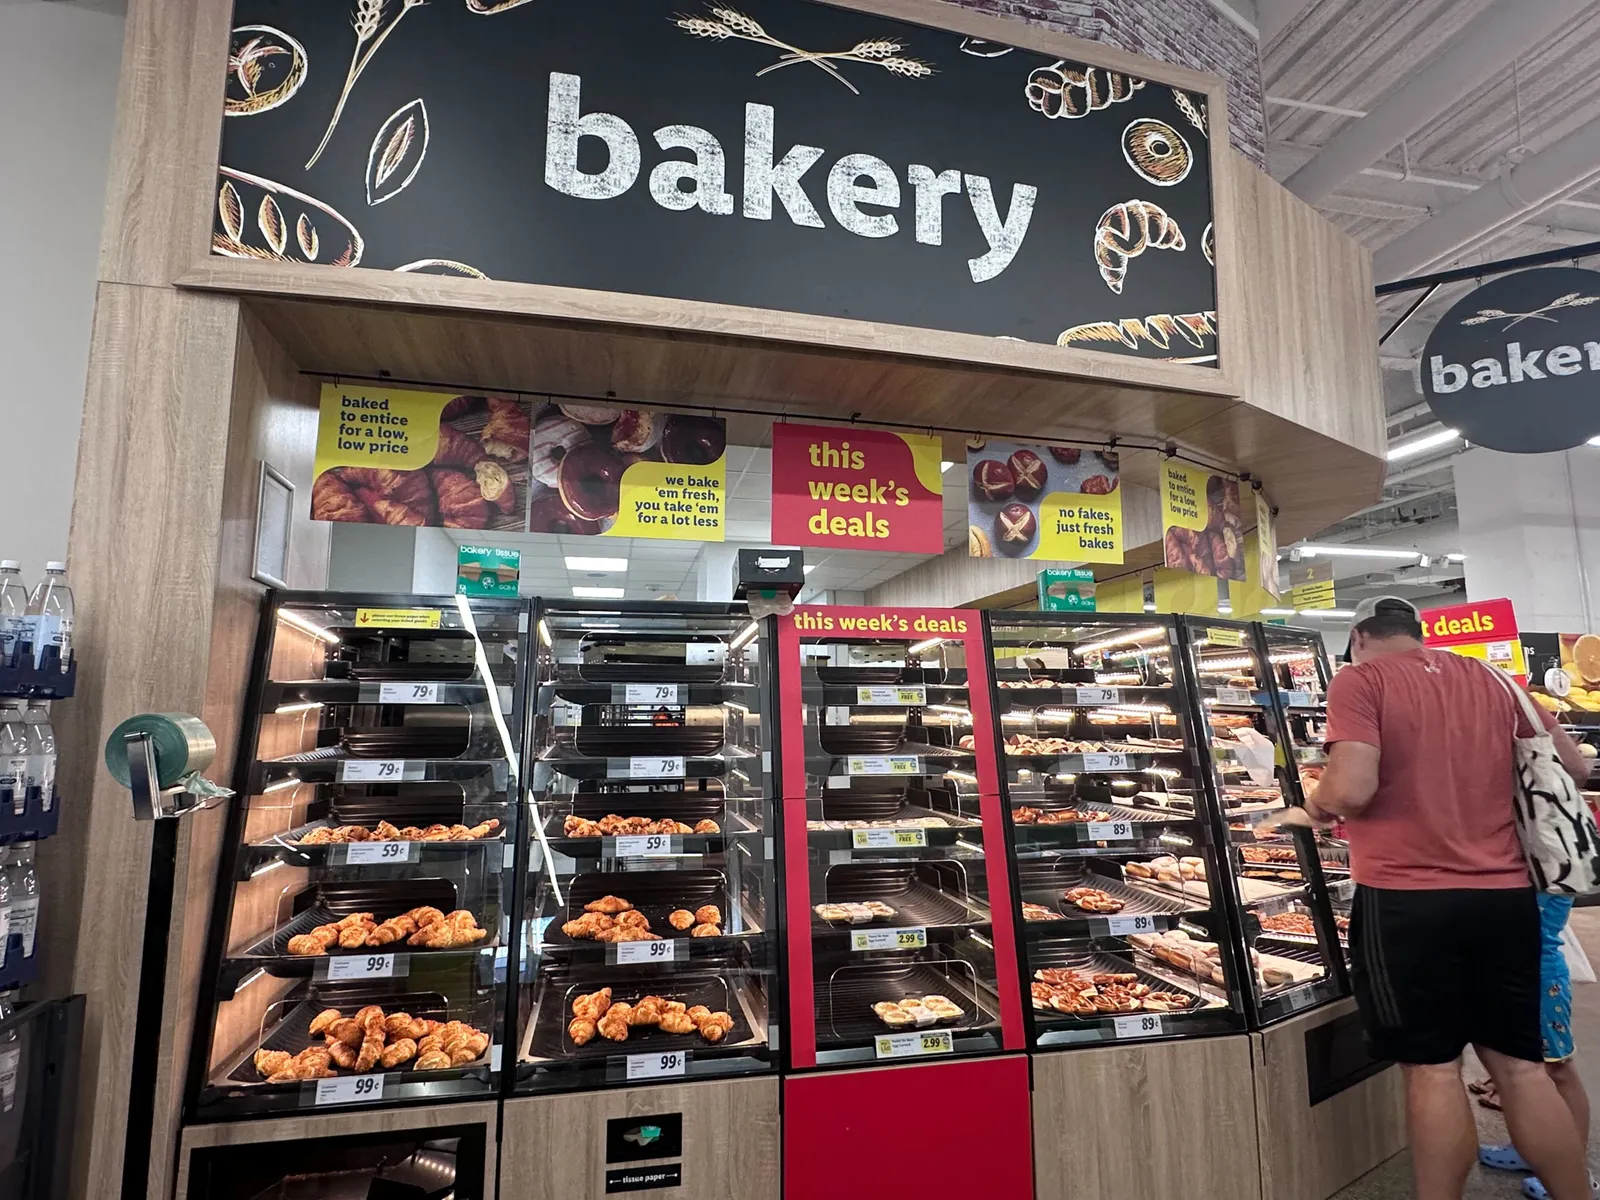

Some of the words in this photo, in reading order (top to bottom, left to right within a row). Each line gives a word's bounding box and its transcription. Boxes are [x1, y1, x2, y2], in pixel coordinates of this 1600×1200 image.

[544, 72, 1038, 283] bakery
[342, 396, 389, 411] baked
[340, 410, 356, 422] to
[361, 412, 408, 426] entice
[339, 424, 361, 436] for
[366, 428, 374, 437] a
[378, 426, 408, 442] low,
[338, 437, 365, 450] low
[369, 440, 408, 454] price
[809, 442, 865, 470] this
[666, 477, 684, 485] we
[688, 476, 719, 487] bake
[1168, 469, 1187, 483] baked
[682, 488, 719, 502] fresh,
[808, 479, 909, 506] week’s
[1169, 482, 1175, 490] to
[1177, 484, 1195, 496] entice
[635, 501, 660, 512] you
[664, 501, 692, 512] take
[1170, 491, 1179, 502] for
[1184, 496, 1197, 508] low,
[1059, 509, 1074, 518] no
[1078, 508, 1113, 522] fakes,
[1170, 503, 1182, 514] low
[1182, 507, 1198, 519] price
[638, 512, 657, 523] for
[660, 516, 668, 524] a
[672, 514, 690, 525] lot
[694, 516, 718, 527] less
[808, 508, 890, 538] deals
[1057, 520, 1080, 534] just
[1083, 522, 1113, 535] fresh
[1079, 537, 1114, 549] bakes
[460, 545, 492, 556] bakery
[496, 548, 519, 558] tissue
[1046, 569, 1071, 577] bakery
[1307, 568, 1314, 579] 2
[794, 612, 834, 630] this
[839, 614, 909, 632] week’s
[914, 615, 967, 634] deals
[1434, 611, 1494, 637] deals
[899, 934, 915, 943] 2.99
[924, 1038, 940, 1048] 2.99
[622, 1176, 644, 1184] tissue
[645, 1174, 665, 1182] paper
